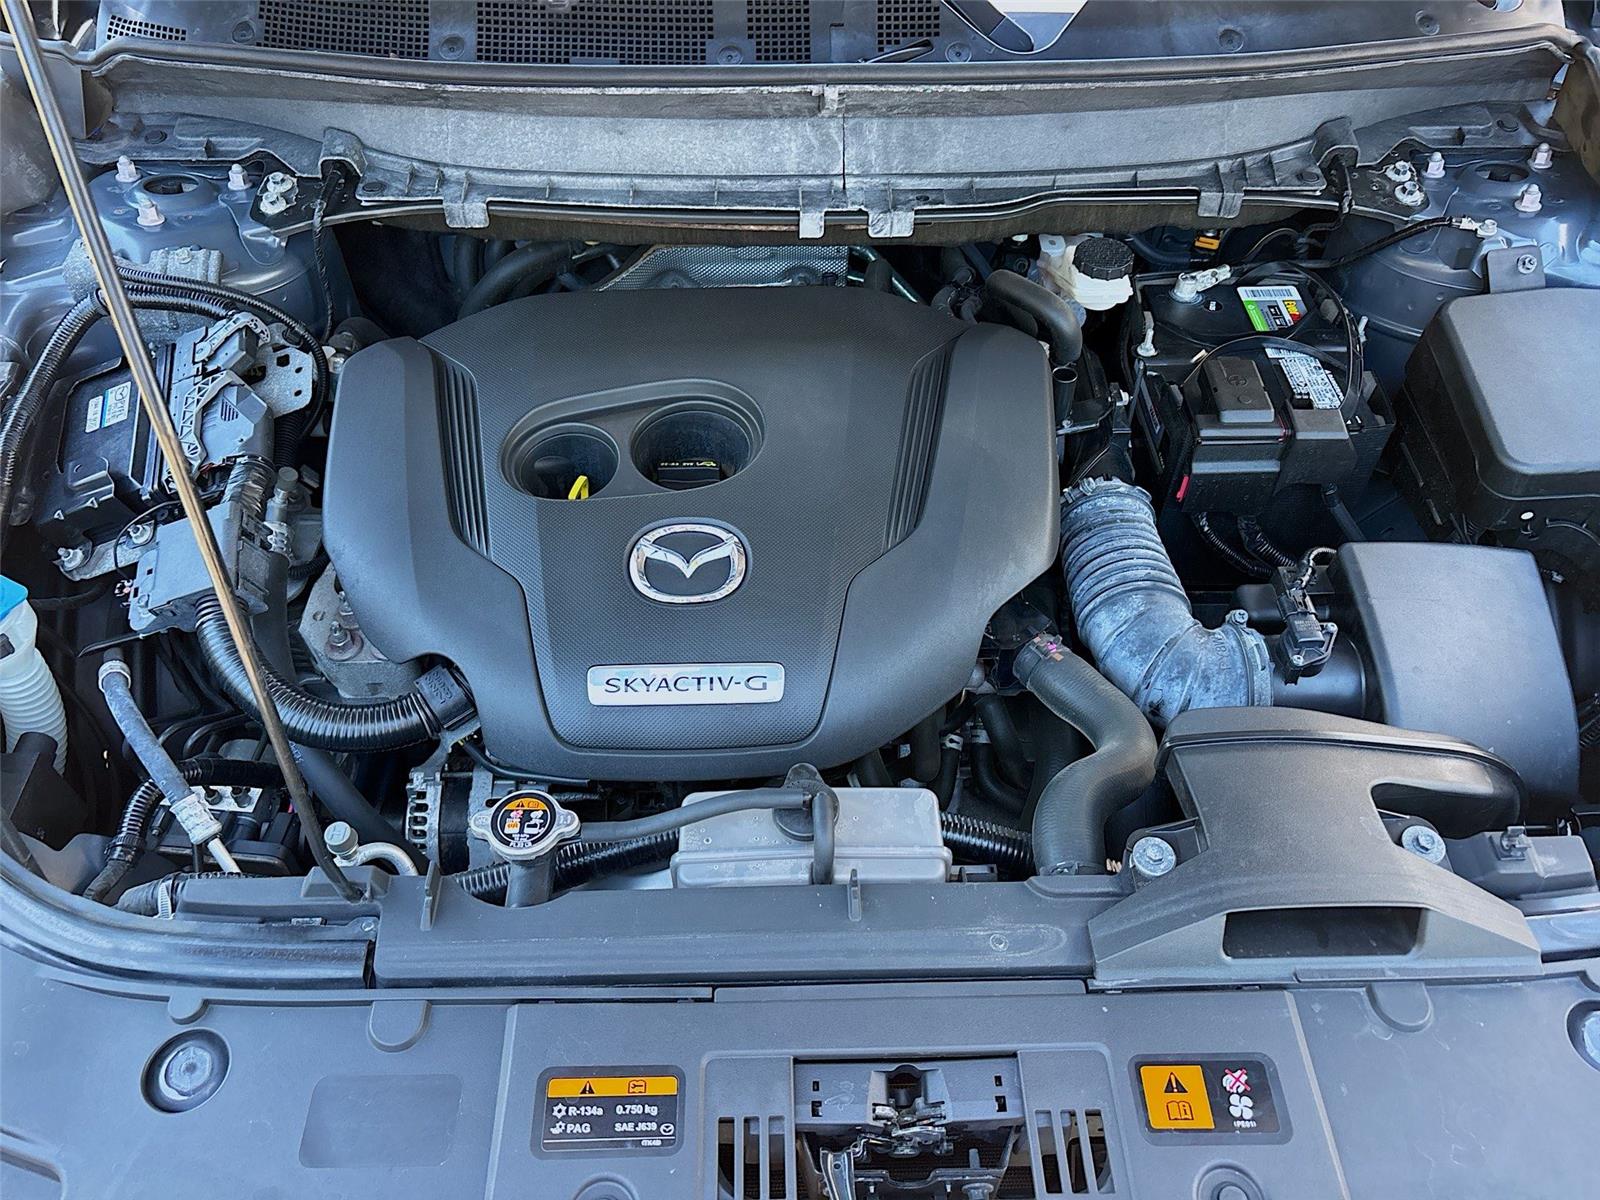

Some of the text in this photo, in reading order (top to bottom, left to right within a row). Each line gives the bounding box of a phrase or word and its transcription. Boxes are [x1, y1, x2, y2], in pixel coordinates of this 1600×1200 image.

[604, 675, 768, 693] SKYACTIV-G
[568, 1104, 658, 1116] R-134a 0.750 kg
[566, 1122, 657, 1134] PAG SAE J639
